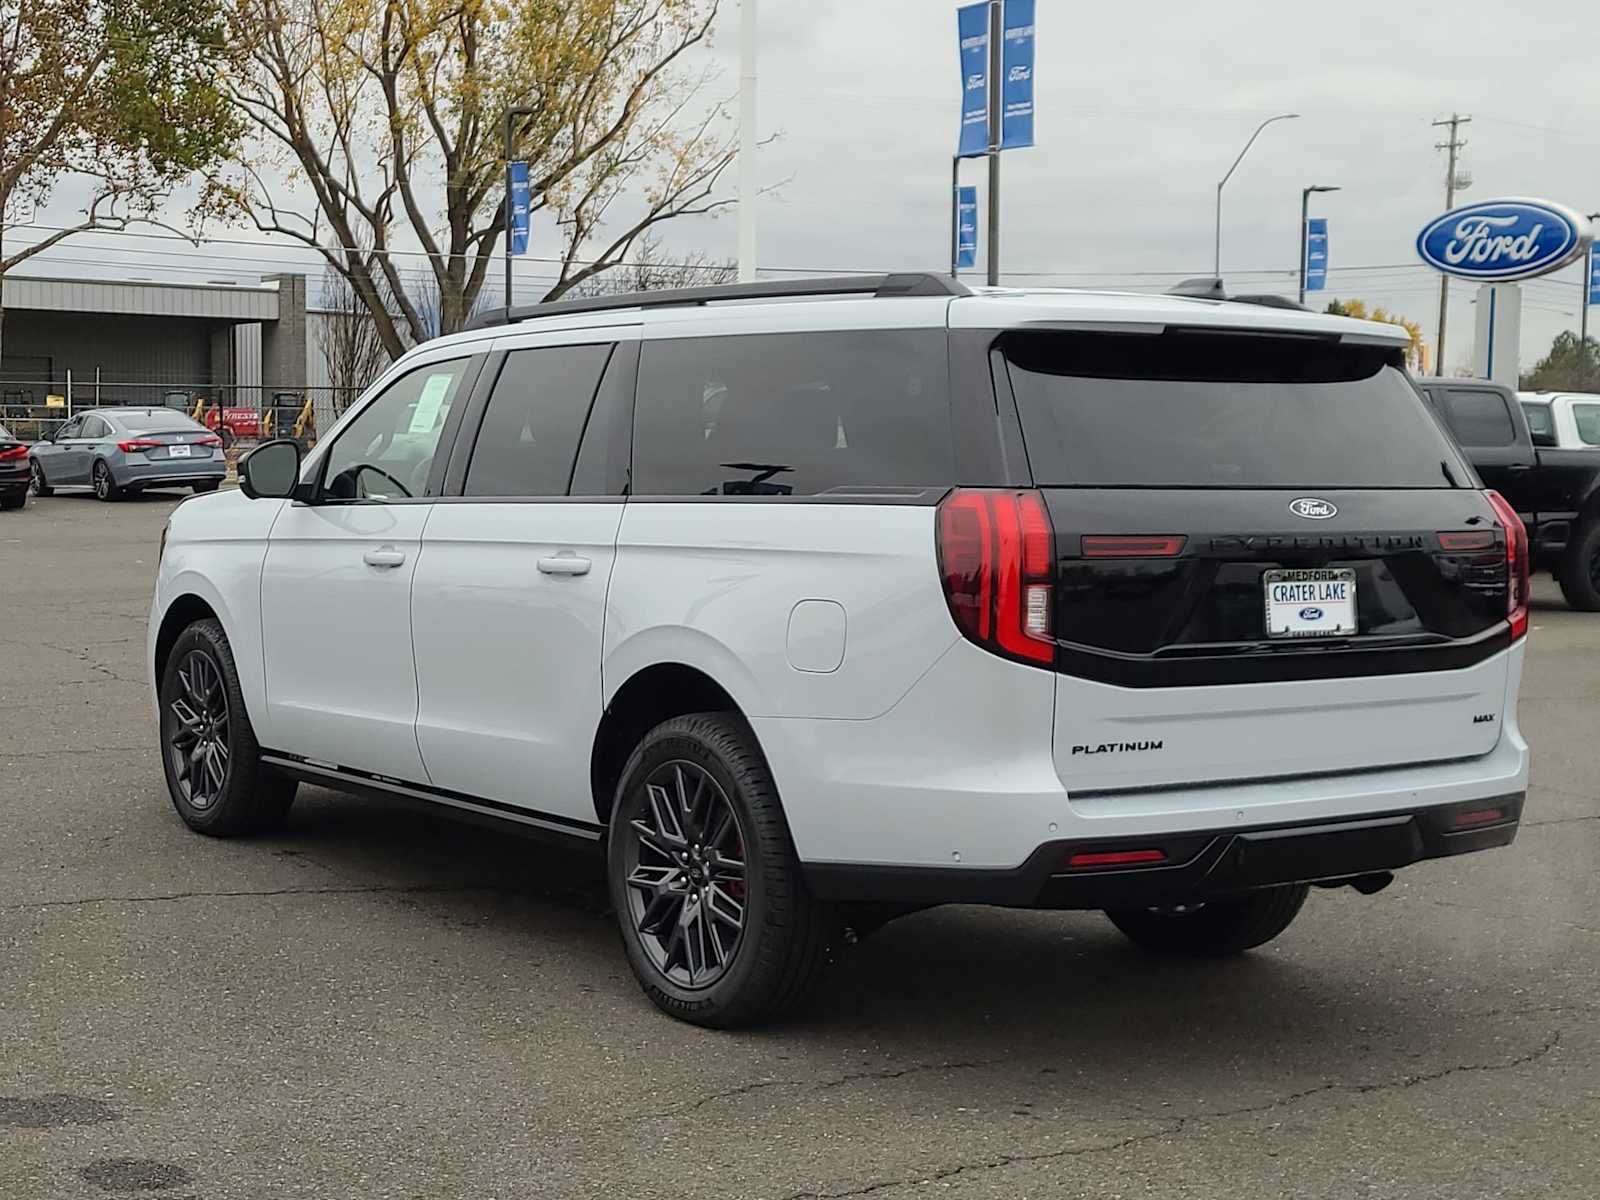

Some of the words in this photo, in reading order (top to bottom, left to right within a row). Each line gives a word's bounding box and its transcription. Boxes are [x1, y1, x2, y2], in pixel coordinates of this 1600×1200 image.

[1009, 65, 1032, 82] Ford
[1446, 215, 1544, 263] Ford
[1209, 535, 1424, 552] EXPEDITION
[1287, 570, 1334, 581] MEDFORD
[1273, 584, 1316, 602] CRATER
[1319, 583, 1346, 600] LAKE
[1473, 713, 1496, 723] MAX
[1072, 740, 1163, 755] PLATINUM
